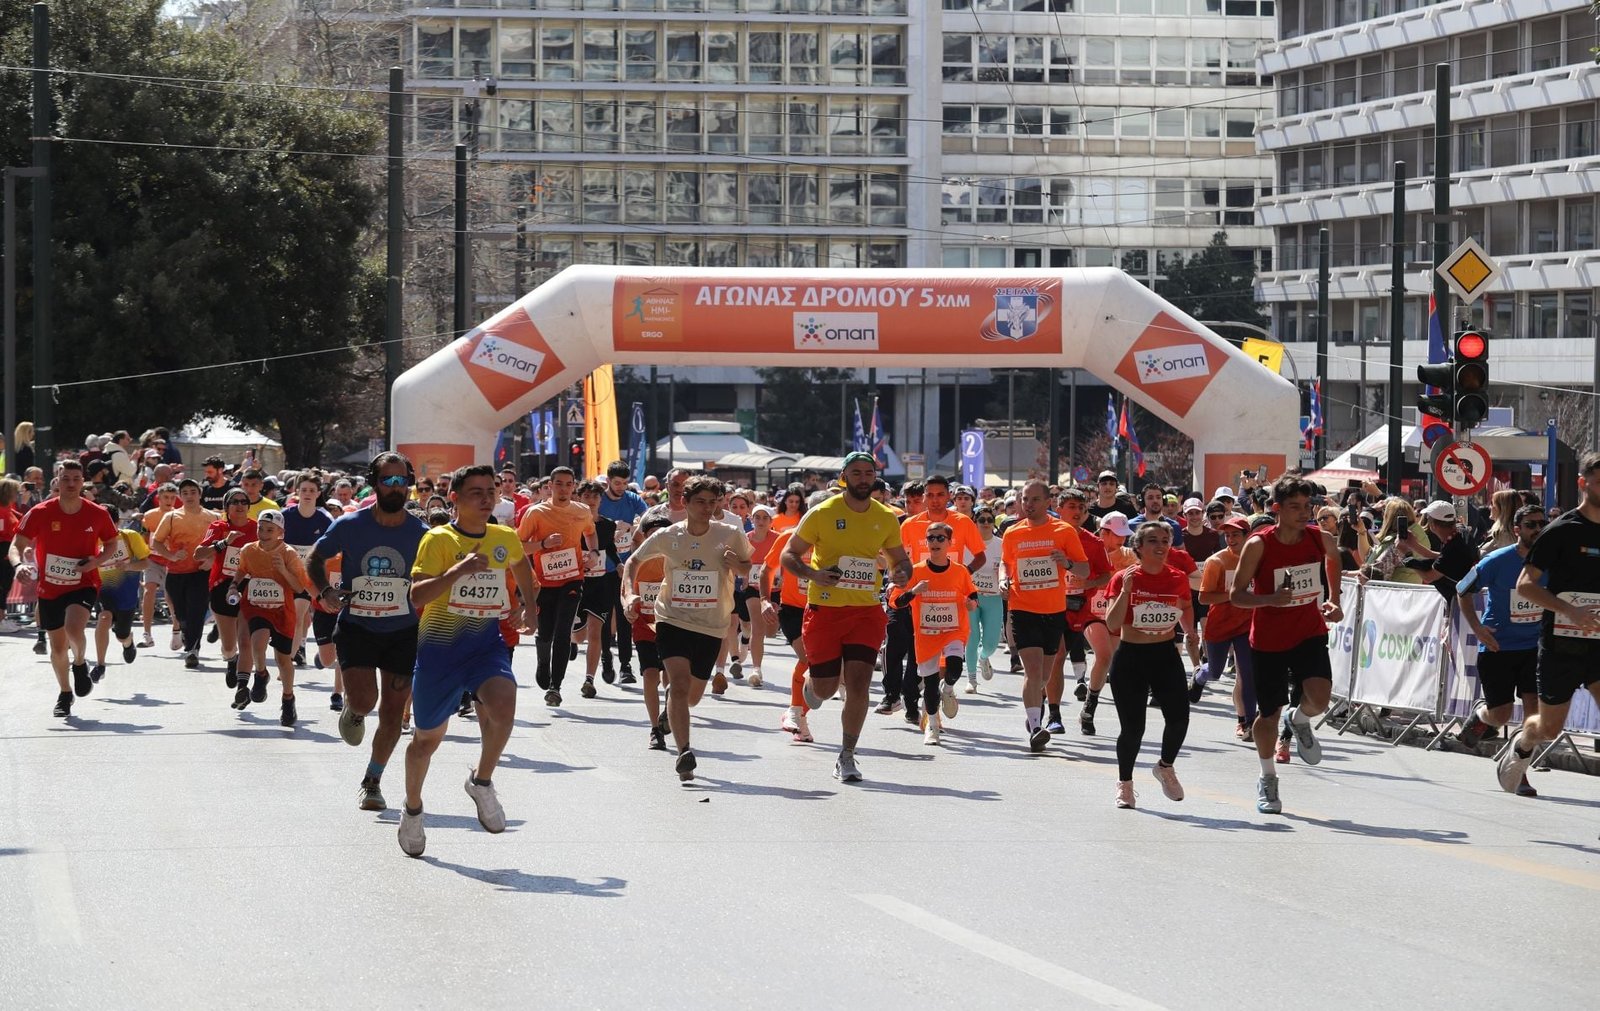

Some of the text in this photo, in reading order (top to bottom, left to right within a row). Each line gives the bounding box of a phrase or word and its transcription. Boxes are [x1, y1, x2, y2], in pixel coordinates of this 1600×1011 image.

[695, 285, 971, 308] ΑΓΩΝΑΣ ΔΡΟΜΟΥ 5 ΧΛΜ
[995, 287, 1039, 296] ΣΕΓΑΣ
[645, 297, 675, 305] ΑΘΗΝΑΣ
[966, 434, 976, 455] 2
[50, 565, 77, 577] 63735
[547, 559, 572, 571] 64647
[843, 569, 873, 581] 63306
[1023, 567, 1052, 578] 64086
[678, 583, 712, 594] 63170
[1290, 577, 1313, 591] 4131
[252, 590, 279, 598] 64615
[359, 590, 394, 602] 63719
[459, 585, 499, 599] 64377
[925, 614, 953, 623] 64098
[1140, 612, 1176, 623] 63035
[1377, 633, 1439, 664] COSMOTE
